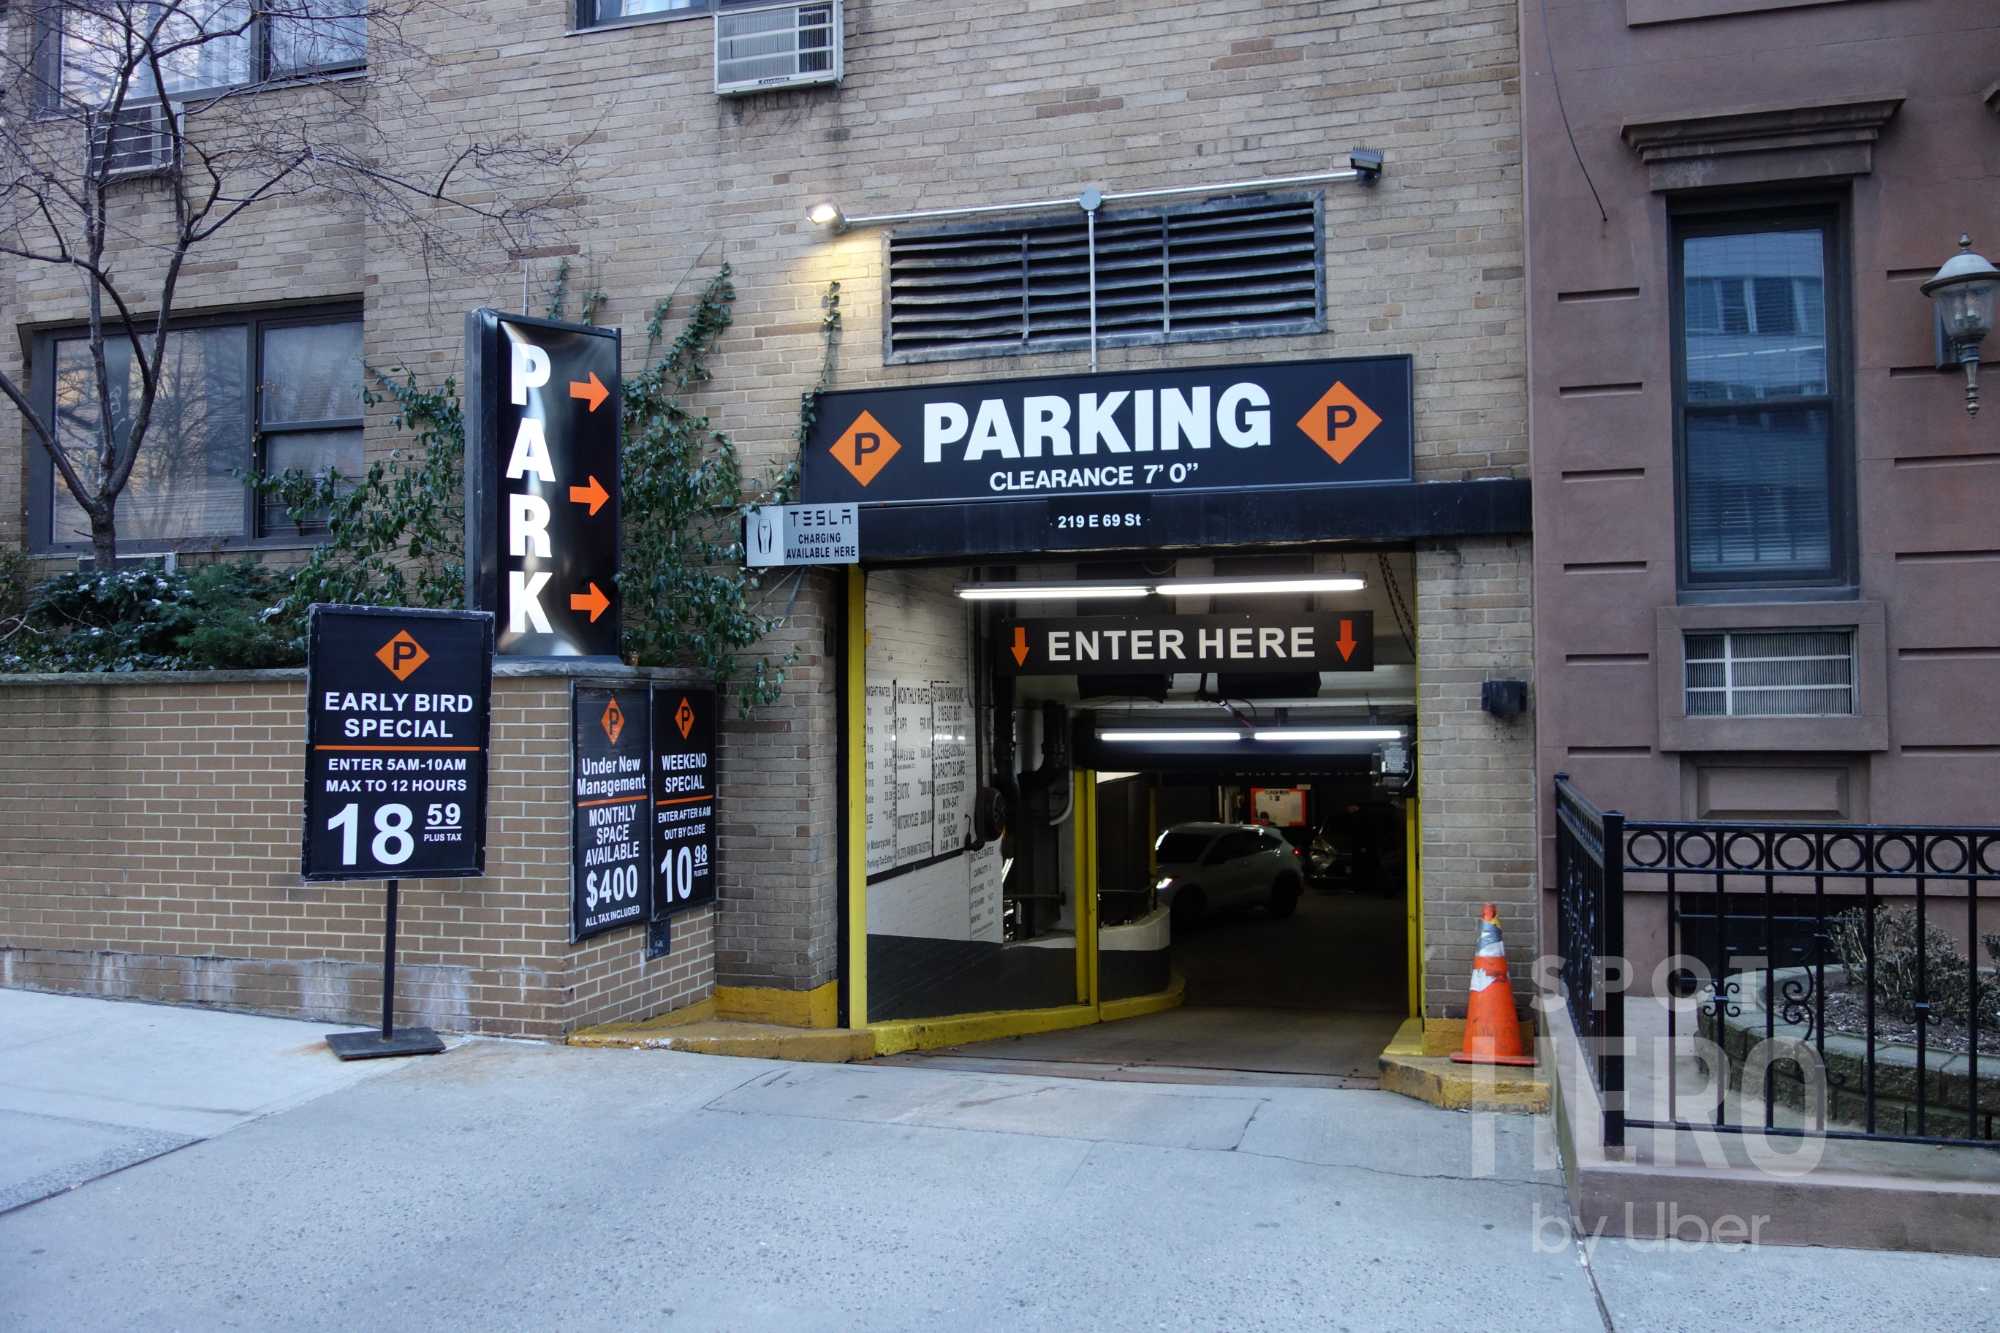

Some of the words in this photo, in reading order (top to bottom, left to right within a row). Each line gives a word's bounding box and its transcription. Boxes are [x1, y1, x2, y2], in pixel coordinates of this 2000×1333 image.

[923, 382, 1271, 463] PARKING
[1326, 404, 1357, 442] P
[854, 432, 881, 466] P
[505, 342, 556, 634] PARK
[989, 465, 1134, 491] CLEARANCE
[789, 509, 852, 528] TESLA
[1058, 515, 1085, 528] 219
[1088, 514, 1099, 527] E
[1102, 513, 1121, 527] 69
[1124, 513, 1142, 526] St
[798, 532, 841, 545] CHARGING
[786, 546, 830, 559] AVAILABLE
[834, 545, 856, 557] HERE
[1048, 628, 1186, 662] ENTER
[1198, 626, 1316, 660] HERE
[393, 641, 416, 671] P
[325, 691, 409, 711] EARLY
[414, 693, 473, 713] BIRD
[344, 718, 454, 738] SPECIAL
[681, 706, 690, 731] P
[328, 758, 383, 771] ENTER
[386, 758, 467, 771] 5AM-10AM
[582, 756, 617, 775] Under
[619, 755, 640, 772] New
[661, 752, 707, 771] WEEKEND
[326, 779, 361, 792] MAX
[366, 779, 387, 792] TO
[391, 779, 408, 792] 12
[412, 779, 467, 792] HOURS
[577, 773, 646, 797] Management
[665, 774, 705, 793] SPECIAL
[589, 804, 637, 827] MONTHLY
[658, 810, 678, 823] ENTER
[678, 807, 698, 820] AFTER
[327, 803, 415, 865] 18
[426, 802, 461, 826] 59
[423, 833, 445, 842] PLUS
[446, 833, 462, 842] TAX
[596, 824, 630, 845] SPACE
[664, 828, 677, 840] OUT
[678, 826, 687, 838] BY
[686, 824, 706, 836] CLOSE
[585, 841, 640, 867] AVAILABLE
[660, 846, 693, 903] 10
[694, 844, 708, 864] 98
[586, 864, 638, 912] $400
[585, 916, 598, 928] ALL
[598, 912, 611, 924] TAX
[610, 905, 640, 922] INCLUDED
